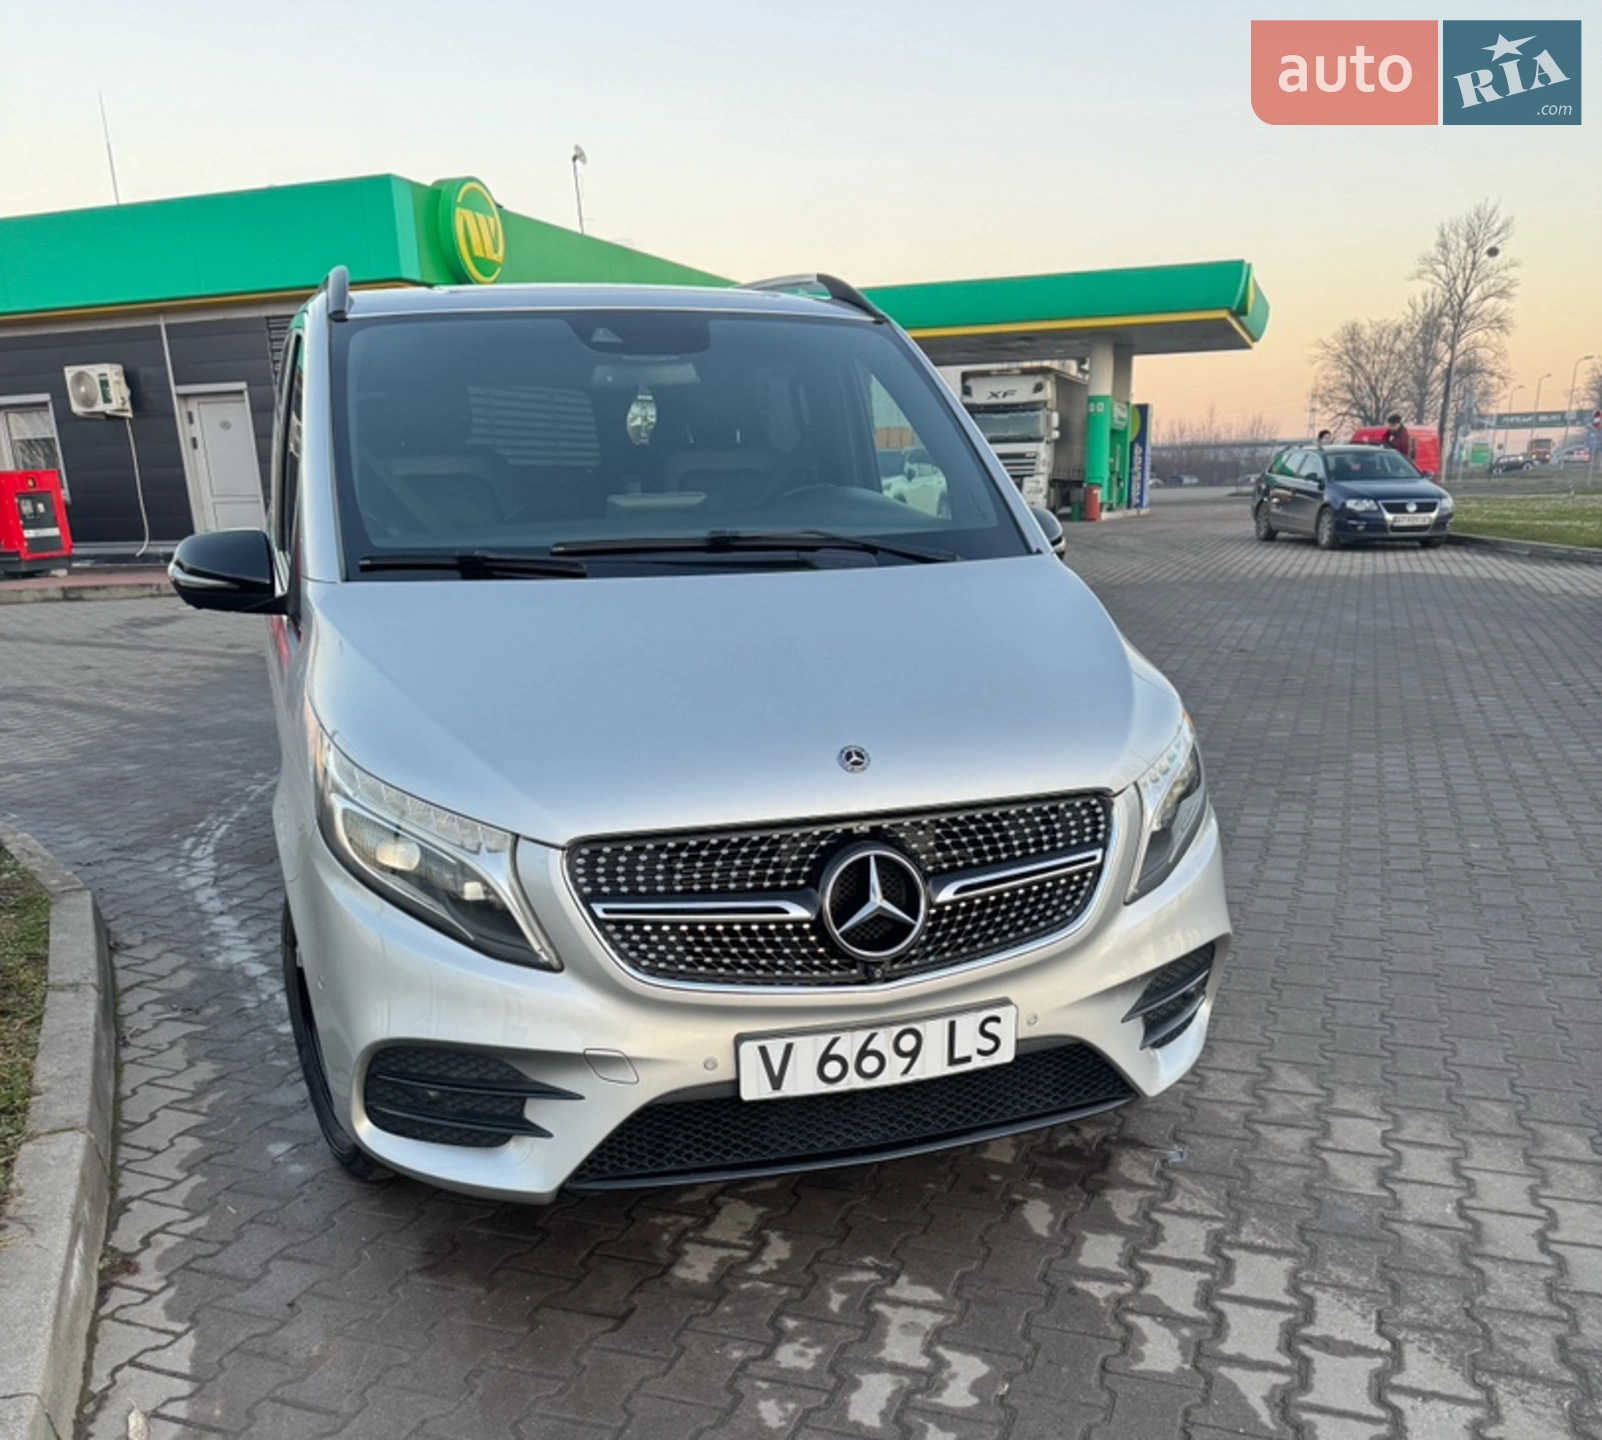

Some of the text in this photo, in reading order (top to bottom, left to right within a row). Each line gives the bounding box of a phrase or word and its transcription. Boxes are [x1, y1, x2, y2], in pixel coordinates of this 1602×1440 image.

[986, 389, 1017, 400] XF
[757, 1015, 1002, 1091] V 669 LS
